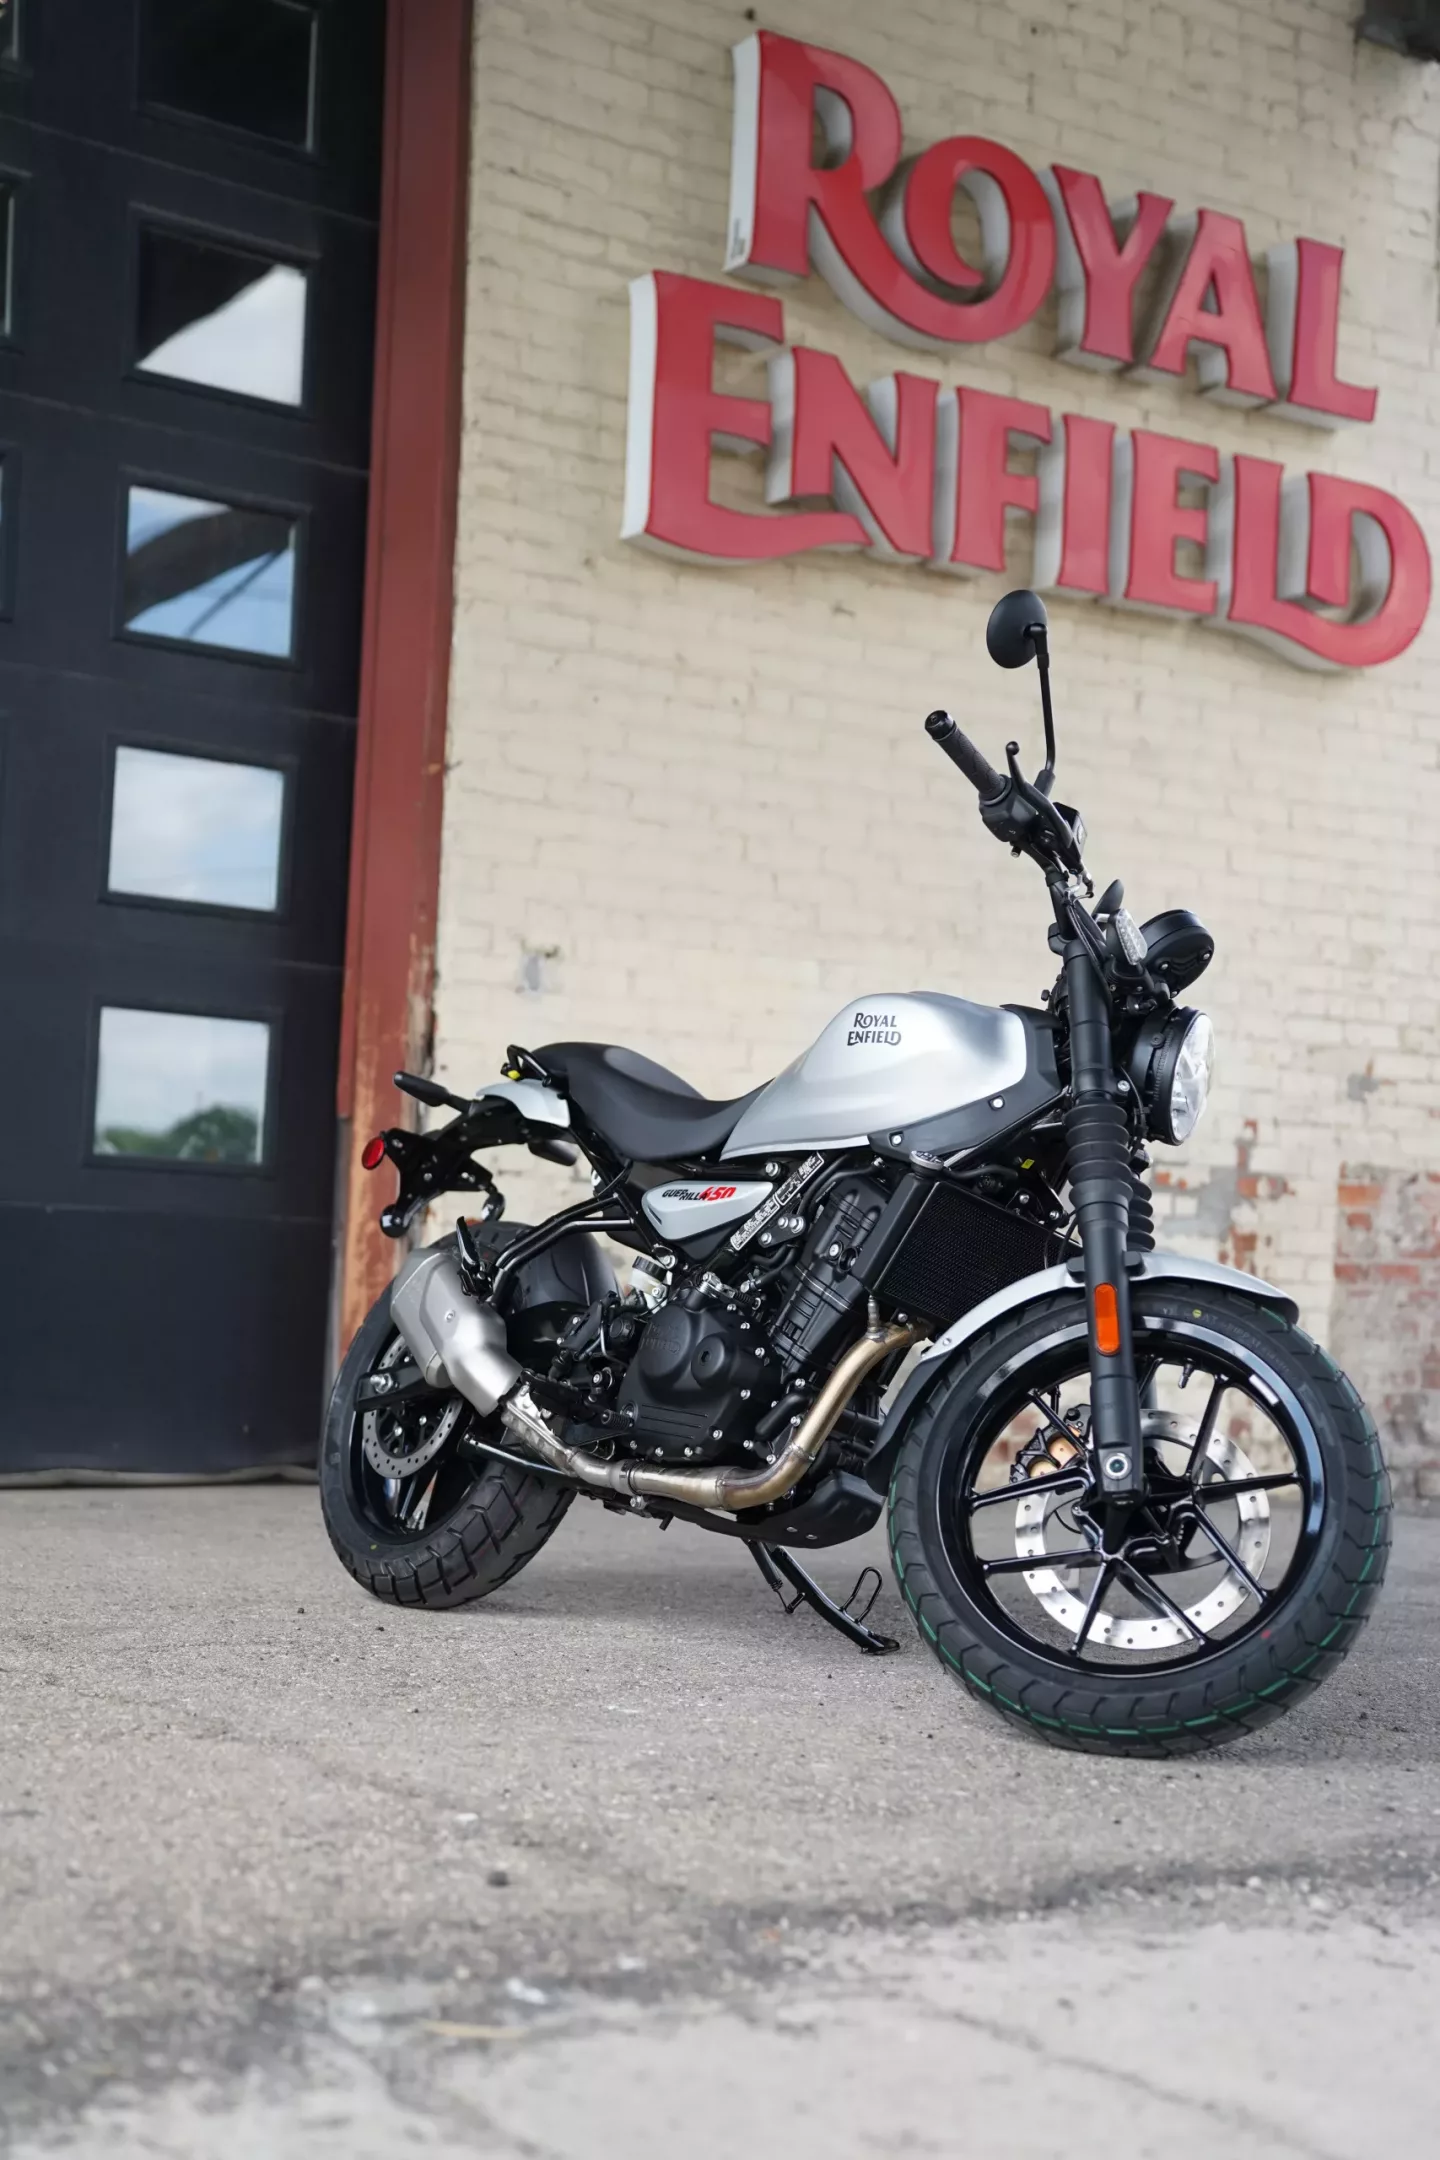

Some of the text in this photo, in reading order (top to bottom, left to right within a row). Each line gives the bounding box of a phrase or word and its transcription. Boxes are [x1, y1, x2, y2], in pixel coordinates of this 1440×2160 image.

[750, 30, 1378, 423] ROYAL
[644, 270, 1433, 667] ENFIELD
[847, 1030, 902, 1046] ENFIELD
[853, 1012, 897, 1029] ROYAL
